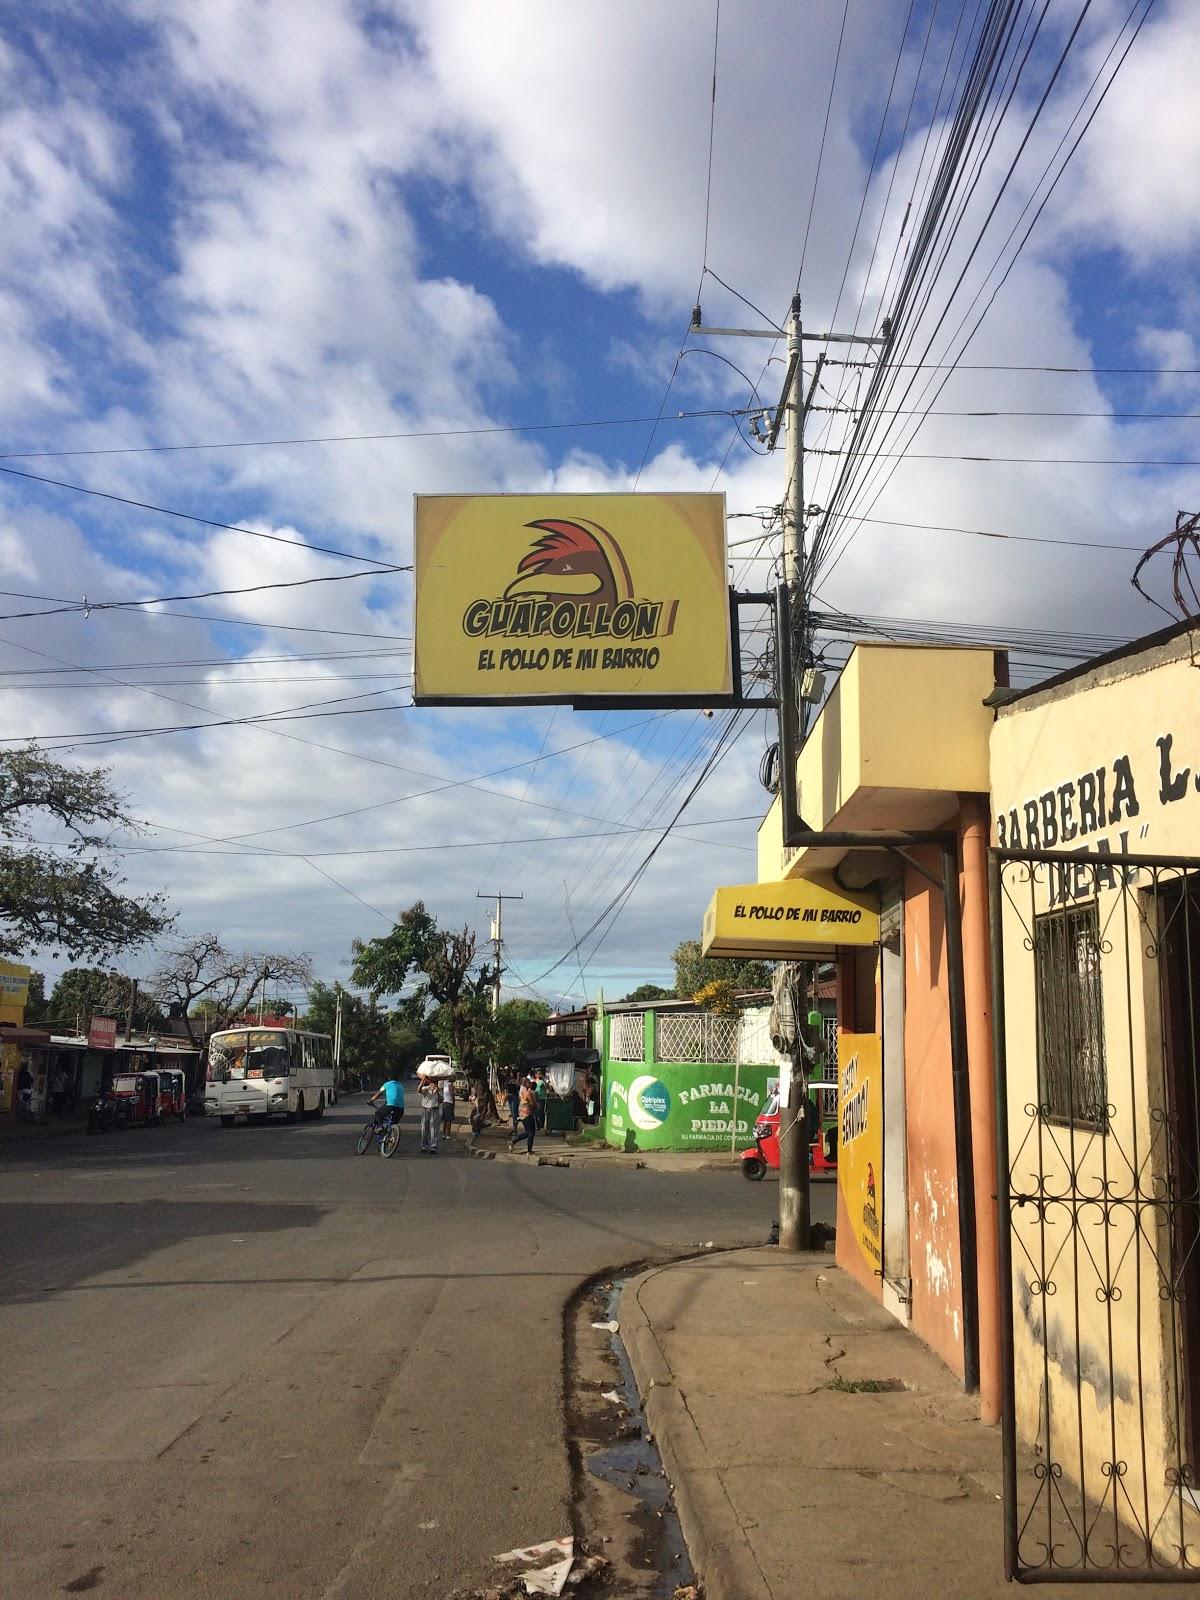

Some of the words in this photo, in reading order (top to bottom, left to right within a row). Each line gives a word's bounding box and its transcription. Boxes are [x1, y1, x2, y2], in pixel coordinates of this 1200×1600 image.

[462, 598, 664, 642] GUAPOLLON
[477, 649, 496, 670] EL
[500, 648, 549, 670] POLLO
[553, 648, 572, 669] DE
[576, 648, 597, 669] MI
[602, 647, 659, 669] BARRIO
[1156, 733, 1200, 806] L
[734, 905, 746, 918] EL
[749, 906, 783, 920] POLLO
[786, 906, 800, 921] DE
[802, 908, 817, 922] MI
[820, 909, 861, 924] BARRIO
[248, 1070, 262, 1078] 262
[678, 1083, 760, 1106] FARMACIA
[709, 1101, 730, 1114] LA
[691, 1119, 749, 1133] PIEDAD
